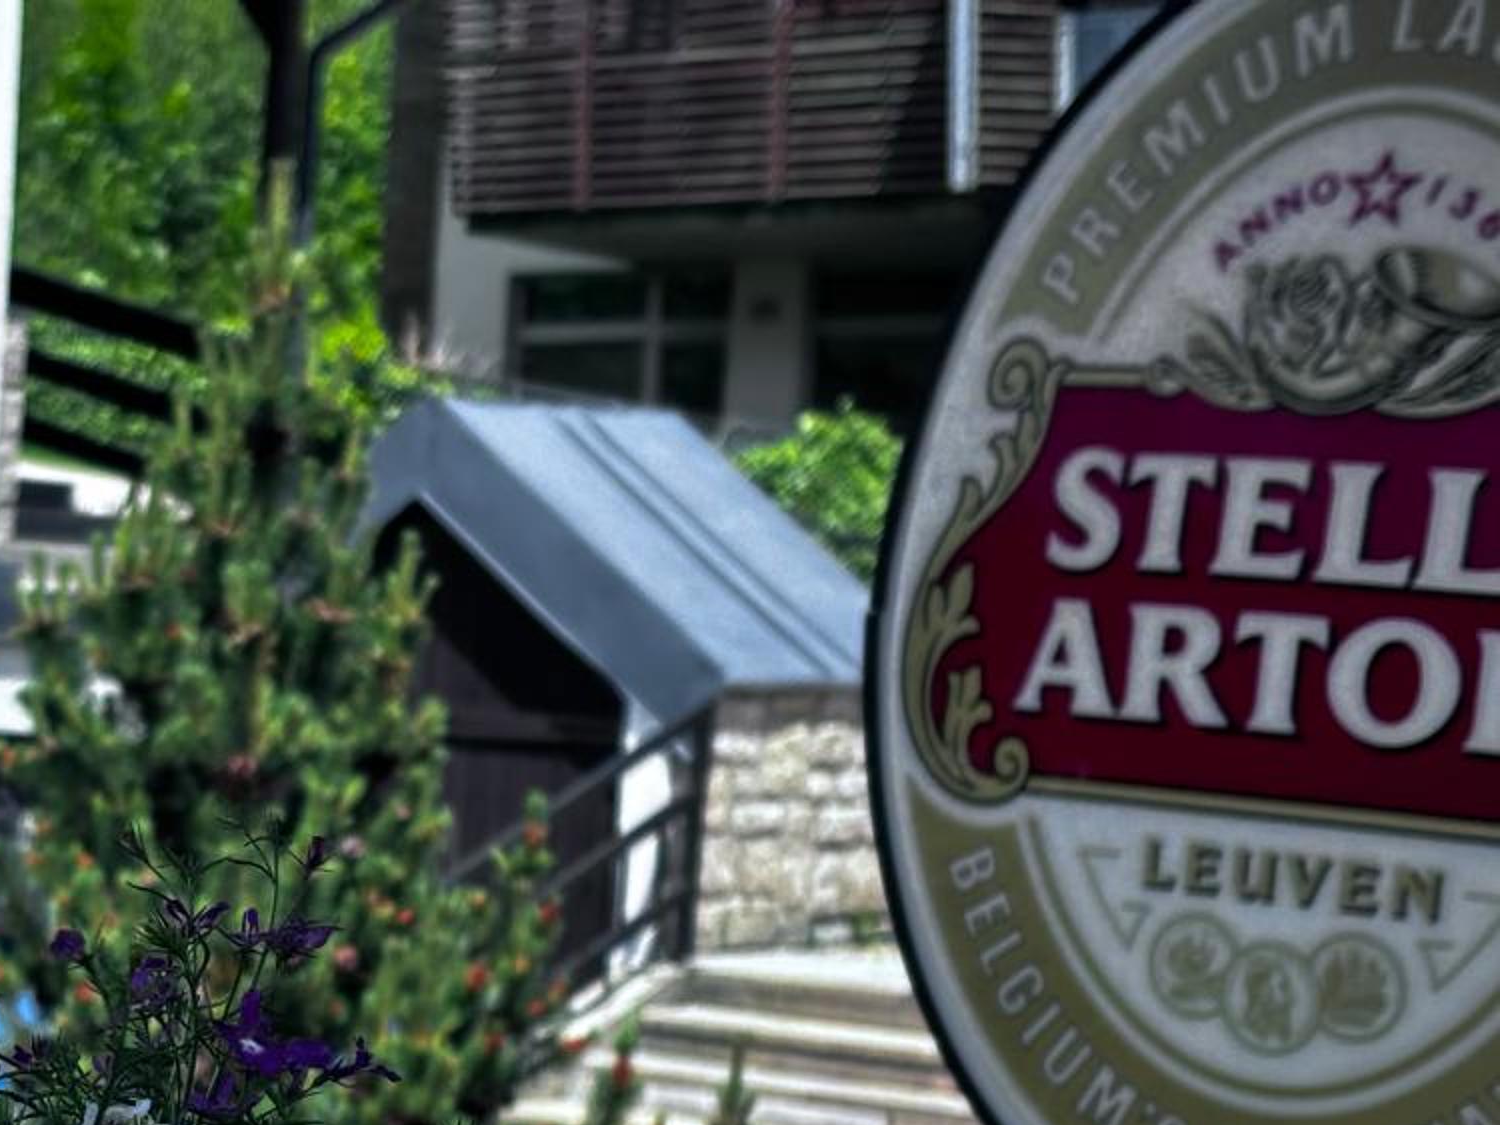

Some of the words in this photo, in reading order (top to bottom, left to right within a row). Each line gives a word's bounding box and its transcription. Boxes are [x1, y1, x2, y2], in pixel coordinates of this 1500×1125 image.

[1043, 4, 1354, 301] PREMIUM
[1394, 0, 1500, 63] LA
[1211, 172, 1340, 271] ANNO
[1046, 446, 1500, 596] STELL
[1141, 836, 1444, 924] LEUVEN
